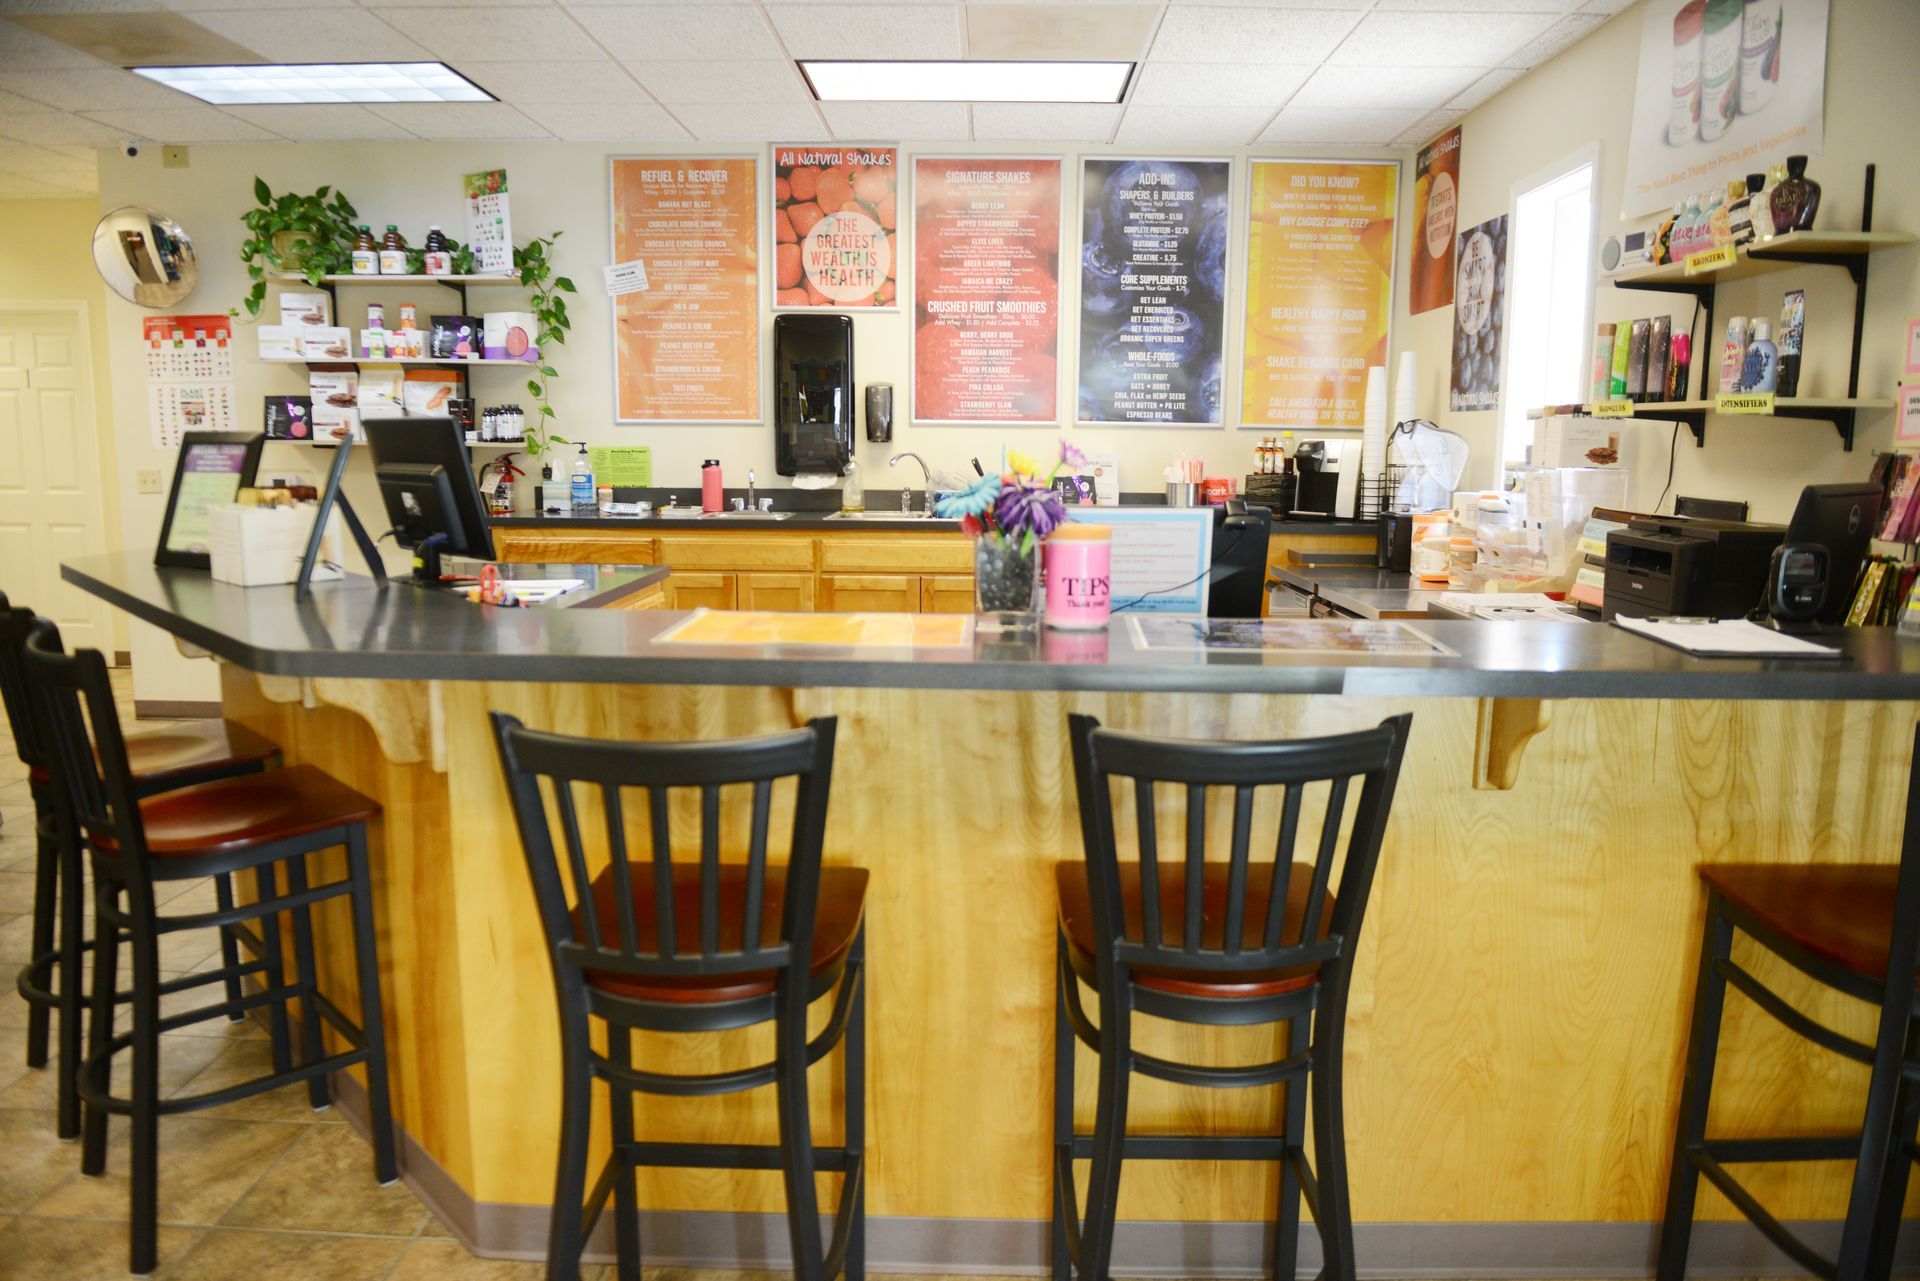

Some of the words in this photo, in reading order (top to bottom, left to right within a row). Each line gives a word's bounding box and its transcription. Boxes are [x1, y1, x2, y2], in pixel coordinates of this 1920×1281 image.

[780, 152, 794, 165] All
[798, 152, 842, 164] Natural
[847, 153, 891, 166] Shakes
[641, 170, 673, 181] REFUEL
[678, 170, 684, 181] &
[688, 170, 728, 181] RECOVER
[946, 172, 993, 183] SIGNATURE
[996, 172, 1030, 183] SHAKES
[1139, 173, 1176, 185] ADD-INS
[1291, 176, 1306, 187] DID
[1309, 176, 1326, 188] YOU
[1328, 176, 1360, 188] KNOW?
[1120, 191, 1150, 199] SHAPERS
[1153, 191, 1158, 199] &
[1162, 192, 1194, 200] BUILDERS
[836, 219, 857, 232] THE
[1279, 216, 1295, 226] WHY
[1297, 217, 1326, 227] CHOOSE
[1327, 218, 1369, 228] COMPLETE?
[1124, 226, 1149, 234] COMPLETE
[817, 235, 876, 248] GREATEST
[1472, 240, 1479, 258] BE
[811, 252, 860, 266] WEALTH
[866, 252, 877, 266] IS
[1693, 251, 1726, 266] BRONZERS
[820, 270, 874, 286] HEALTH
[1121, 275, 1138, 284] CORE
[1140, 275, 1187, 284] SUPPLEMENTS
[928, 302, 967, 313] CRUSHED
[970, 302, 995, 313] FRUIT
[997, 302, 1046, 313] SMOOTHIES
[1272, 307, 1308, 319] HEALTHY
[1343, 309, 1366, 320] HOUR
[1128, 352, 1175, 361] WHOLE-FOODS
[1267, 356, 1296, 367] SHAKE
[1342, 358, 1364, 369] CARD
[1721, 400, 1767, 408] INTENSIFIERS
[1062, 576, 1109, 595] TIPS
